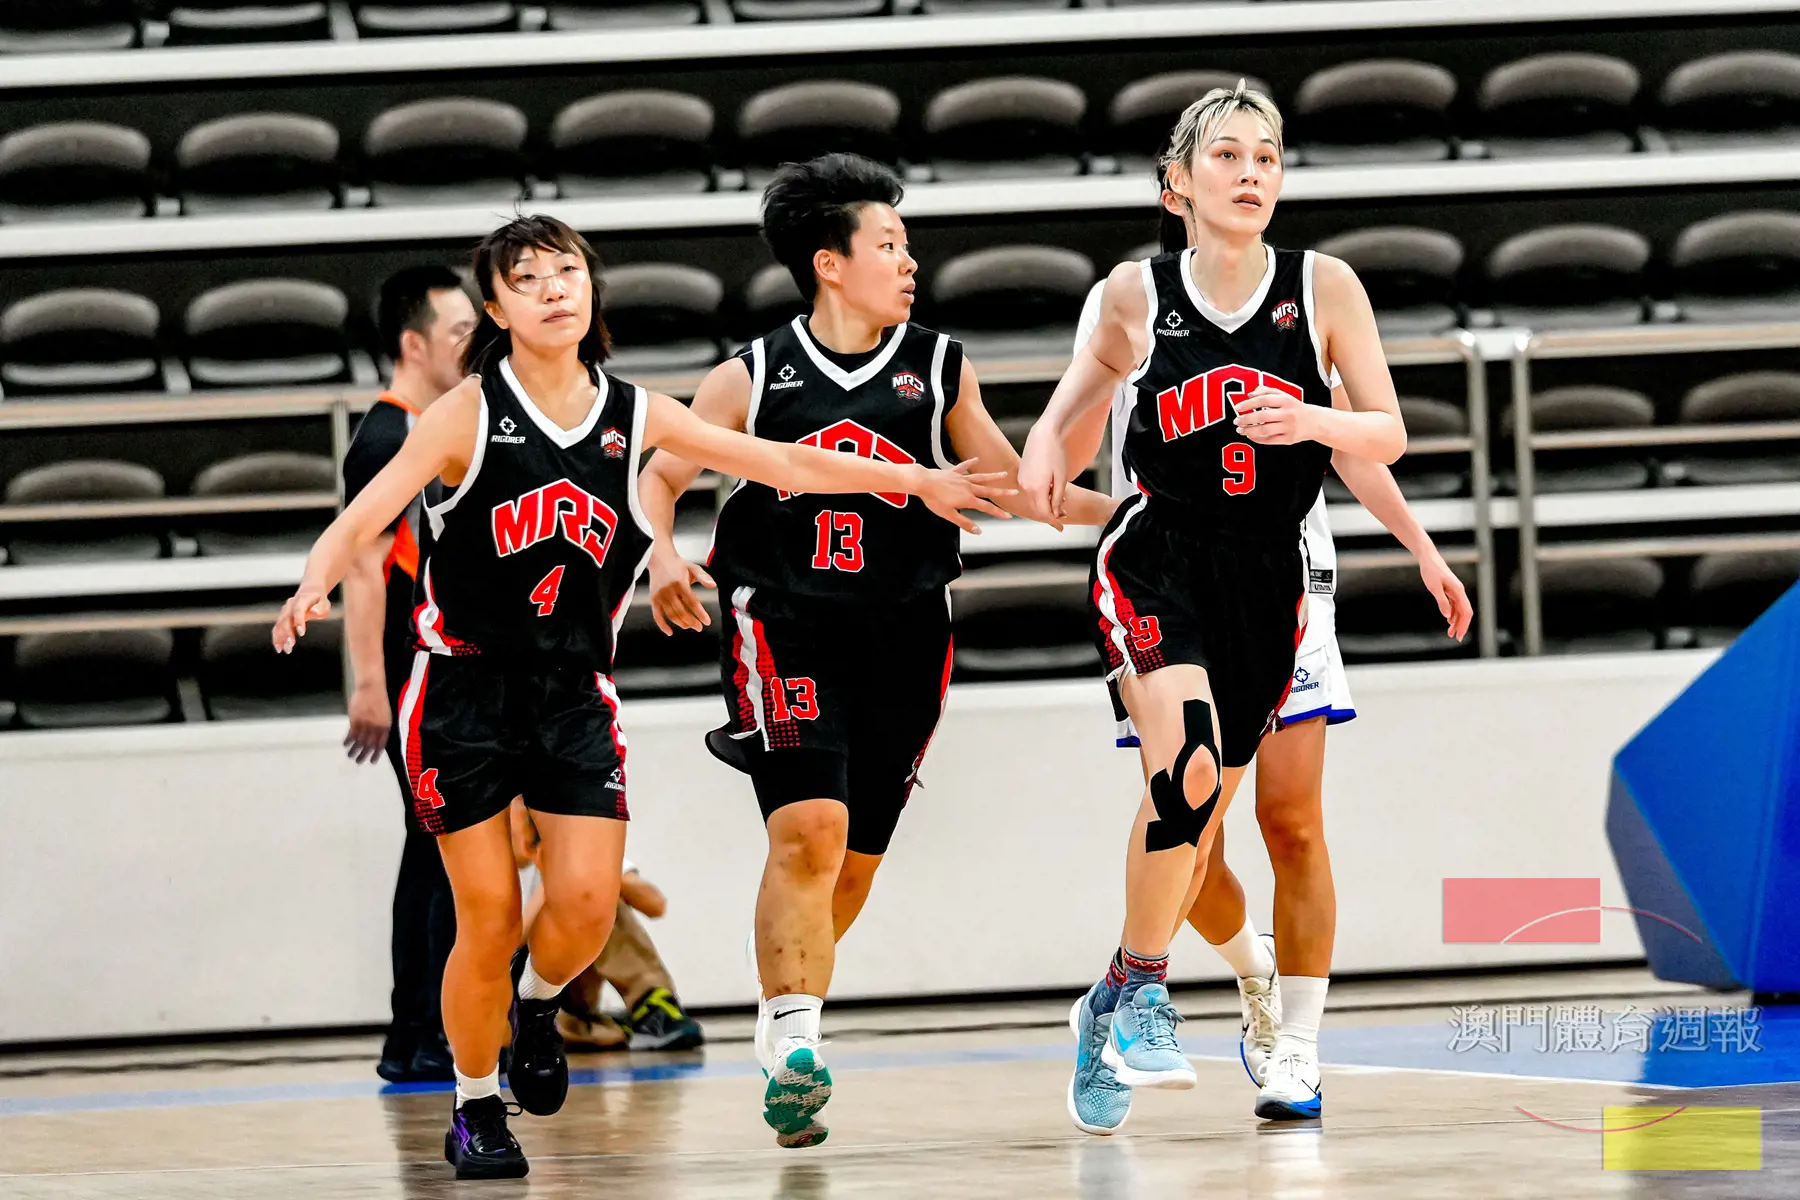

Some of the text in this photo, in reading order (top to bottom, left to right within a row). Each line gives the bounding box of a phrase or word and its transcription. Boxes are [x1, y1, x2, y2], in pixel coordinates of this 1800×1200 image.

[770, 380, 804, 390] RIGORER
[491, 435, 526, 444] RIGORER
[1222, 442, 1256, 496] 9
[812, 509, 864, 572] 13
[529, 565, 565, 616] 4
[1129, 616, 1162, 651] 9
[770, 677, 819, 721] 13
[417, 768, 446, 809] 4
